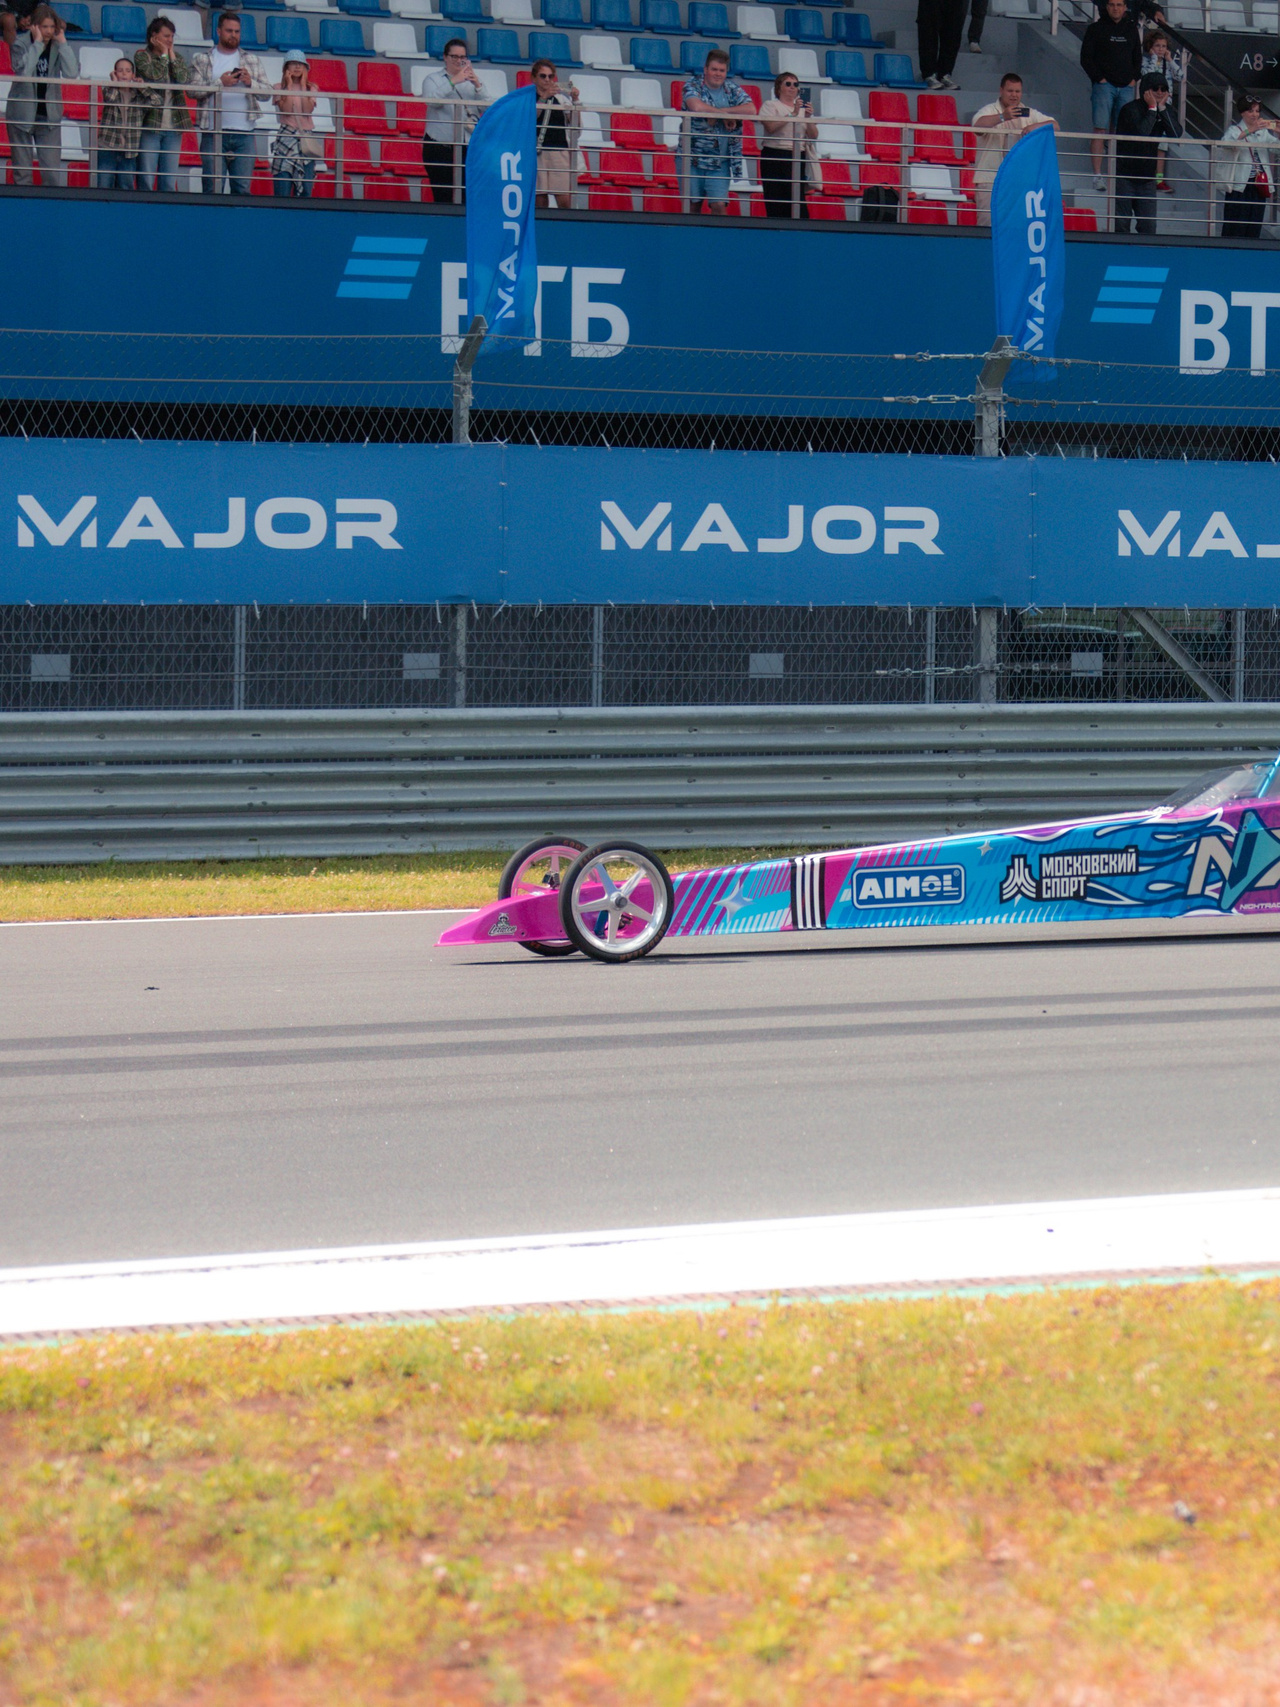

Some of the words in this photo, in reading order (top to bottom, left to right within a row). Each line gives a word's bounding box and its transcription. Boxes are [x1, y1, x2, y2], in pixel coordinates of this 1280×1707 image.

[1239, 53, 1264, 71] A8
[496, 150, 522, 320] MAJOR
[1024, 188, 1046, 350] MAJOR
[18, 495, 403, 549] MAJOR
[600, 501, 944, 555] MAJOR
[1042, 849, 1136, 877] МОСКОВСКИЙ
[1042, 877, 1087, 899] СПОРТ
